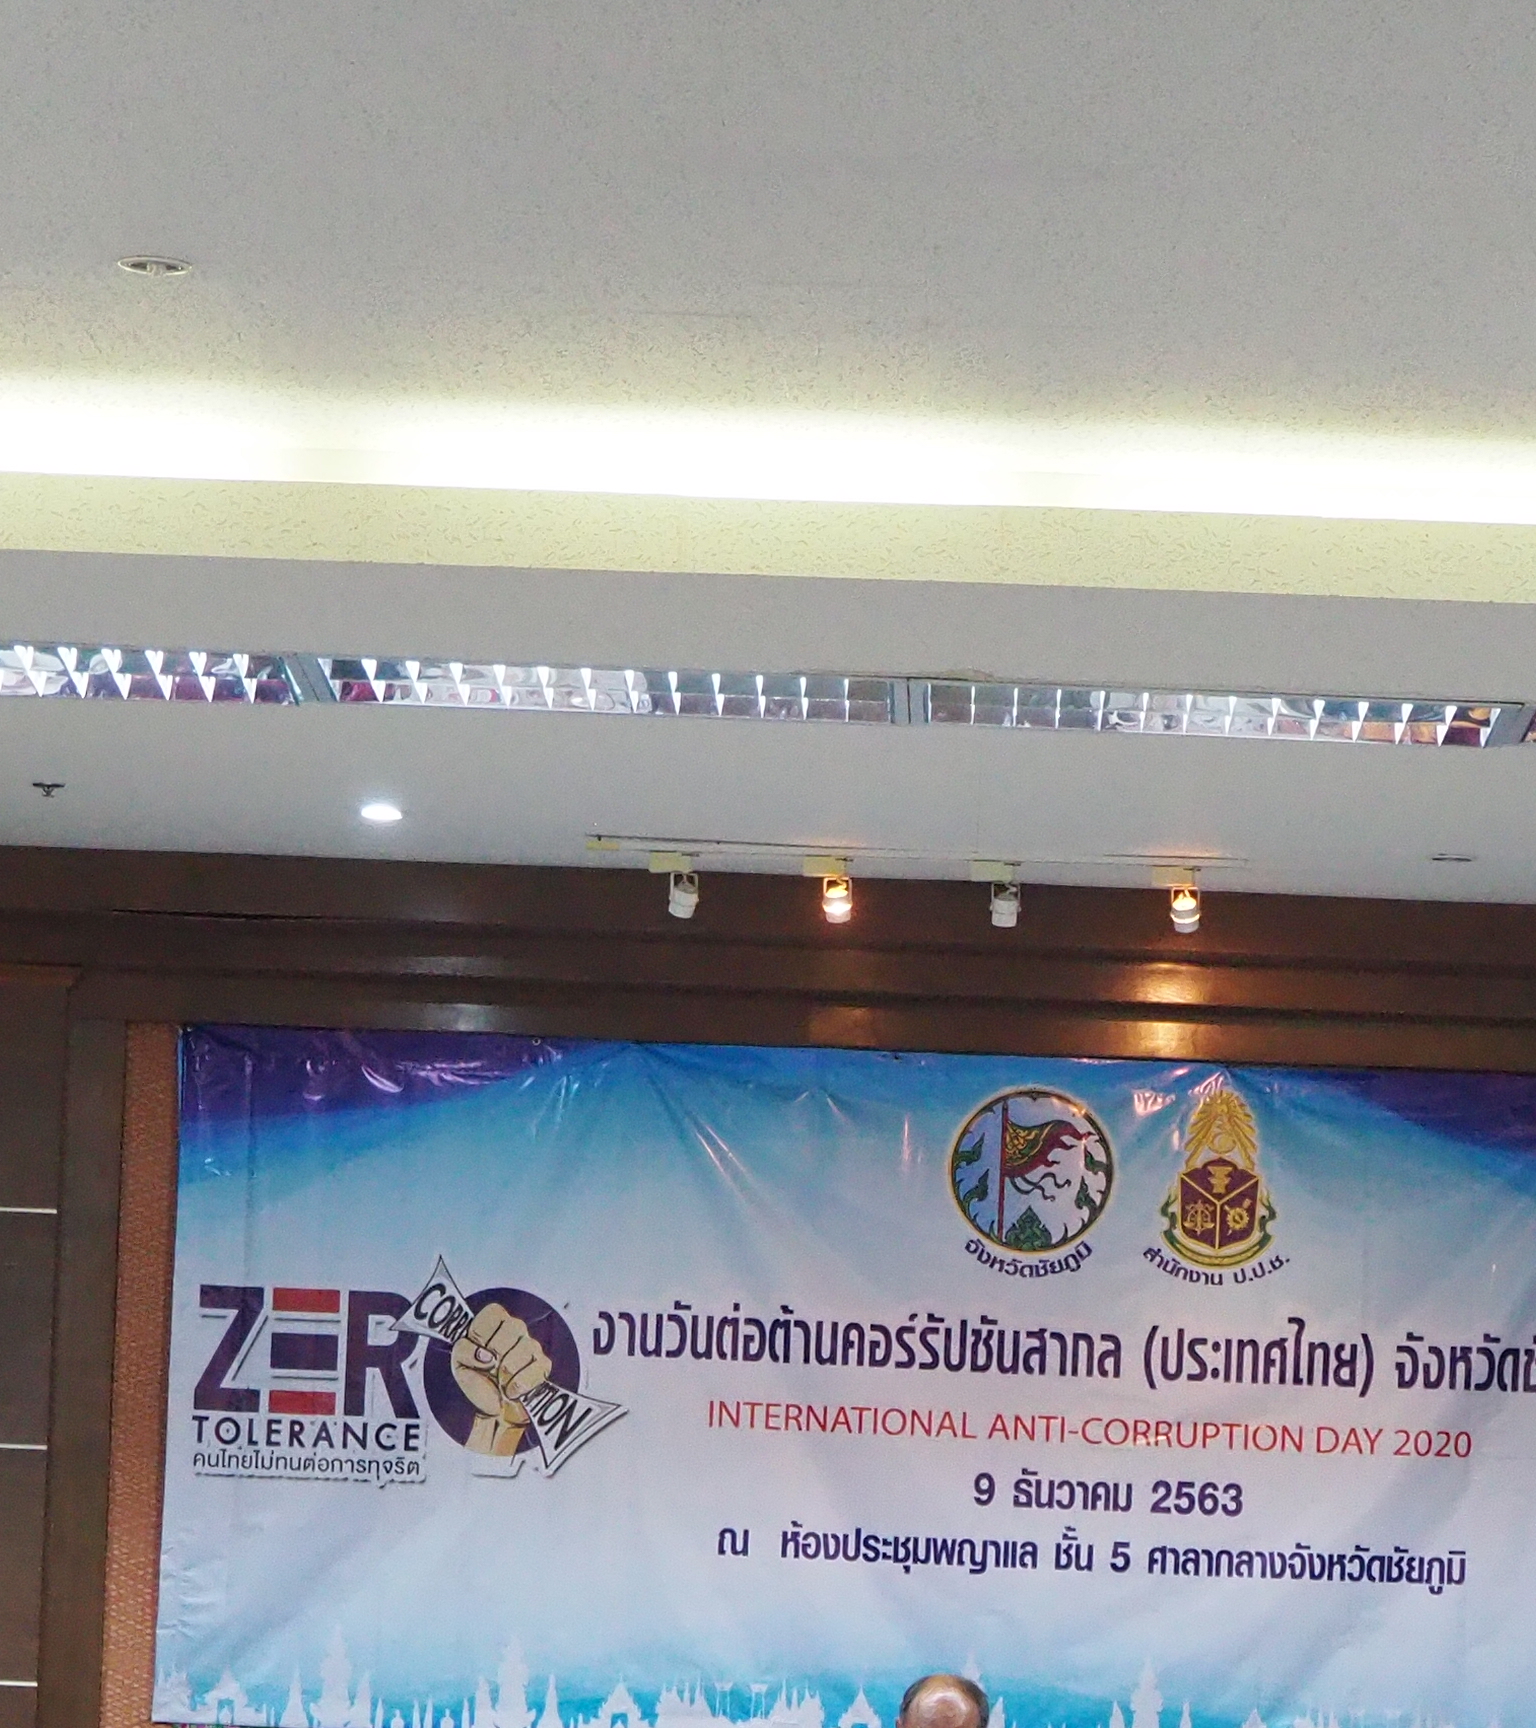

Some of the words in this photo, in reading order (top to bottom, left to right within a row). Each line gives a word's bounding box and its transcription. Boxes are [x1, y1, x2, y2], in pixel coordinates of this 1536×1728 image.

[964, 1238, 1094, 1279] จังหวัดชัยภูมิ
[1142, 1247, 1224, 1287] สำนักงาน
[193, 1284, 581, 1457] ZERO
[591, 1299, 1124, 1380] งานวันต่อต้านคอร์รัปชันสากล
[1142, 1315, 1376, 1400] (ประเทศไทย)
[192, 1415, 421, 1452] TOLERANCE
[707, 1400, 978, 1440] INTERNATIONAL
[987, 1412, 1304, 1454] ANTI-CORRUPTION
[1314, 1424, 1385, 1456] DAY
[1392, 1427, 1474, 1459] 2020
[192, 1447, 421, 1481] คนไทยไม่ทนต่อการทุจริต
[972, 1470, 997, 1508] 9
[1011, 1466, 1134, 1514] ธันวาคม
[1149, 1478, 1244, 1519] 2563
[716, 1526, 751, 1558] ณ
[779, 1518, 1040, 1576] ห้องประชุมพญาแล
[1053, 1524, 1095, 1574] ชั้น
[1108, 1539, 1132, 1575] 5
[1146, 1541, 1468, 1597] ศาลากลางจังหวัดชัยภูมิ
